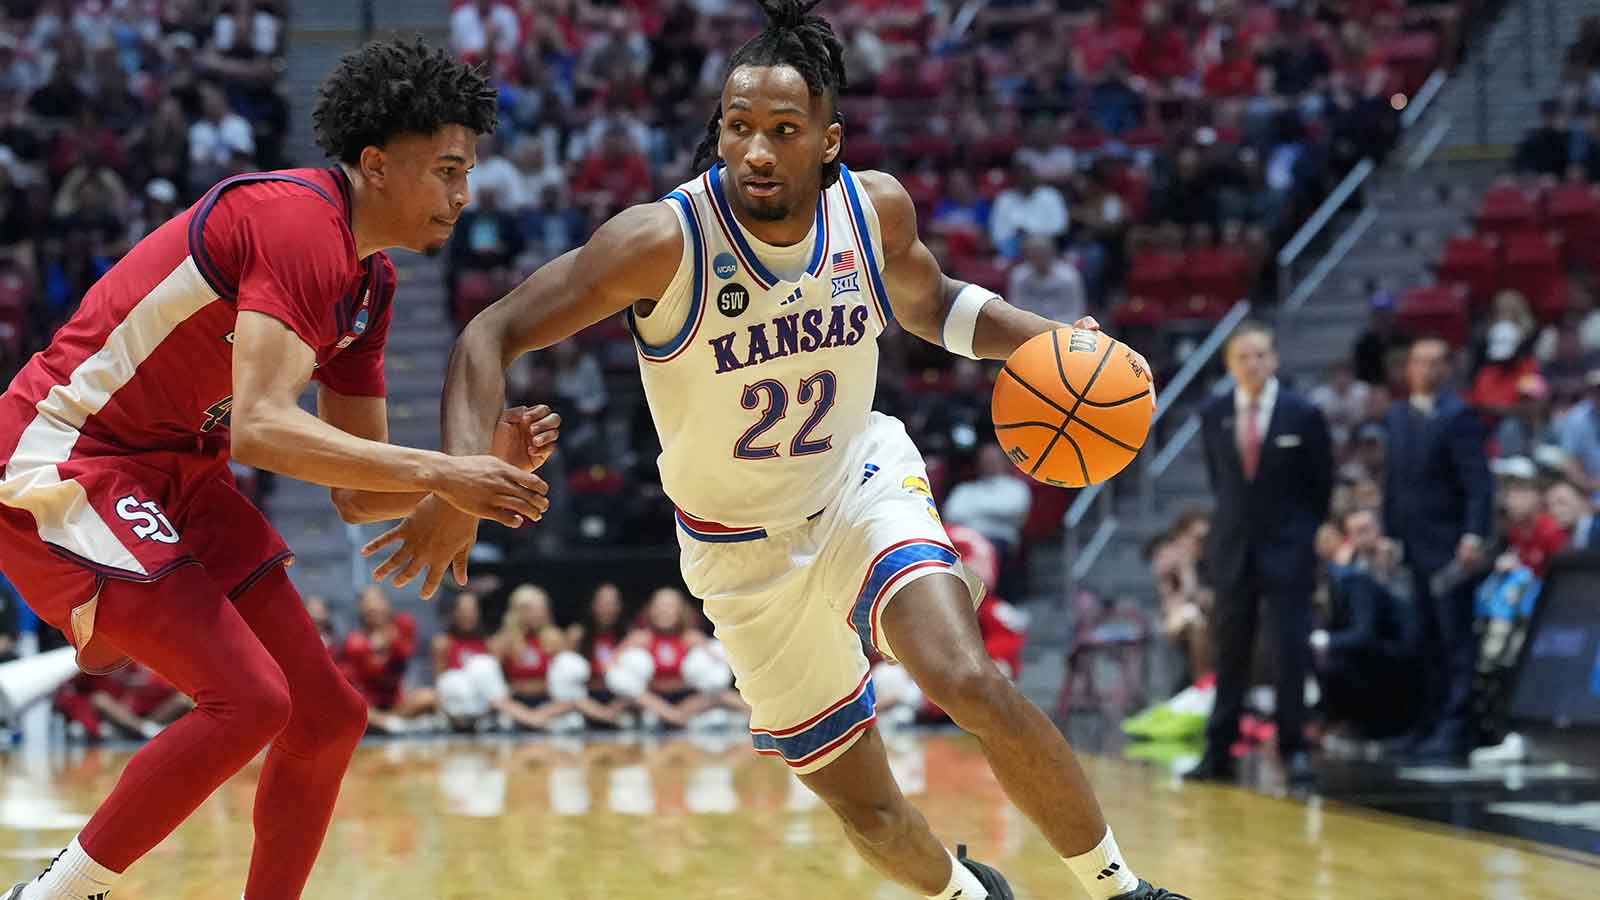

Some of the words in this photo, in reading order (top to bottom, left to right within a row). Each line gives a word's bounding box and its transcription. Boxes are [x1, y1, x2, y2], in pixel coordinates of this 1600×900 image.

[716, 264, 738, 274] NCAA
[721, 291, 745, 310] SW
[709, 304, 868, 374] KANSAS
[733, 369, 837, 460] 22
